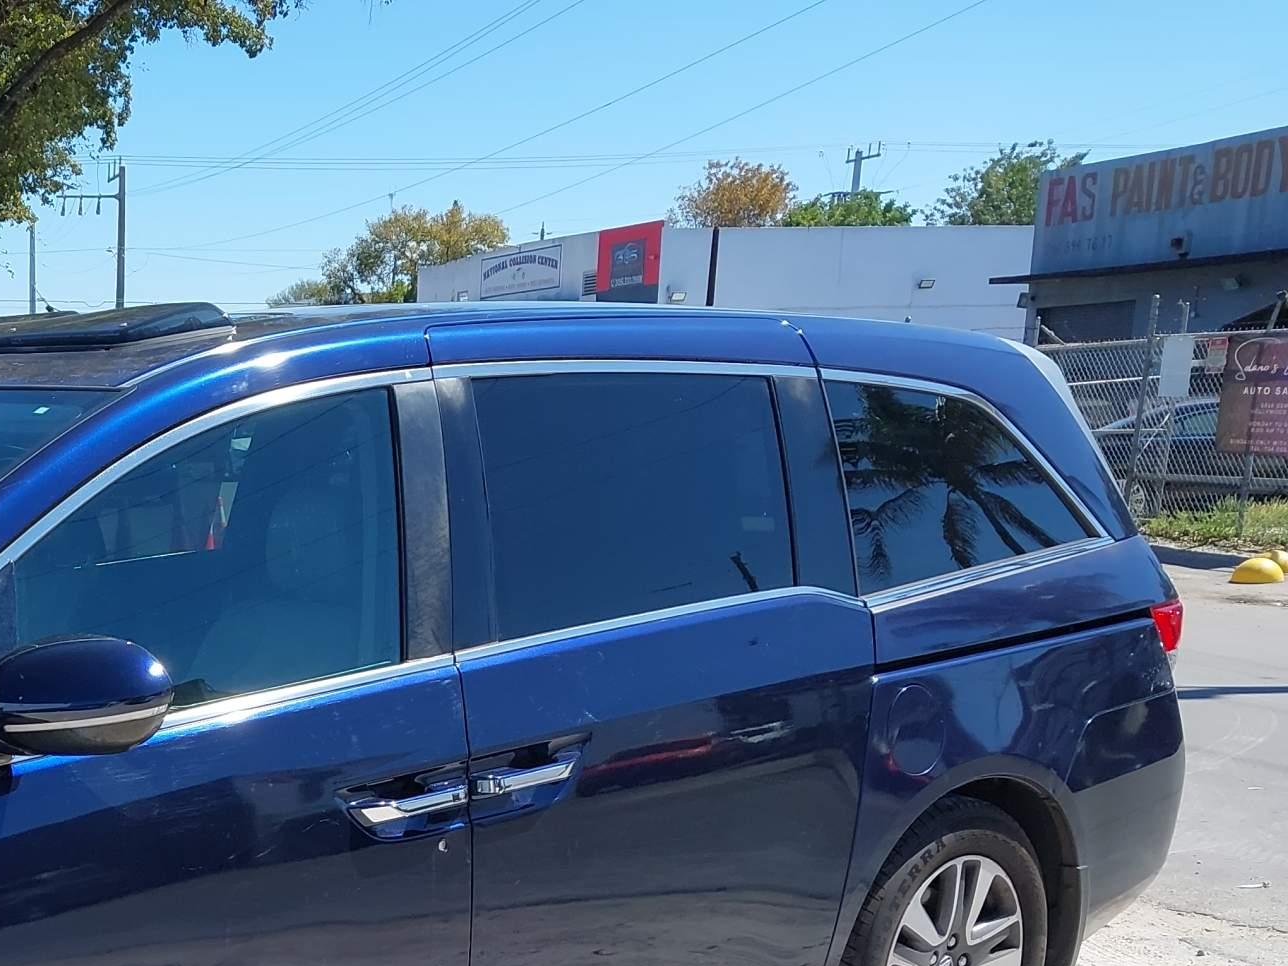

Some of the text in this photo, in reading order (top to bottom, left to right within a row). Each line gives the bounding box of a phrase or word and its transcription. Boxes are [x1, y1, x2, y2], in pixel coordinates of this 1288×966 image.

[1045, 173, 1098, 226] FAS
[483, 254, 559, 281] NATIONAL COLLISION CENTER
[1242, 386, 1271, 396] AUTO
